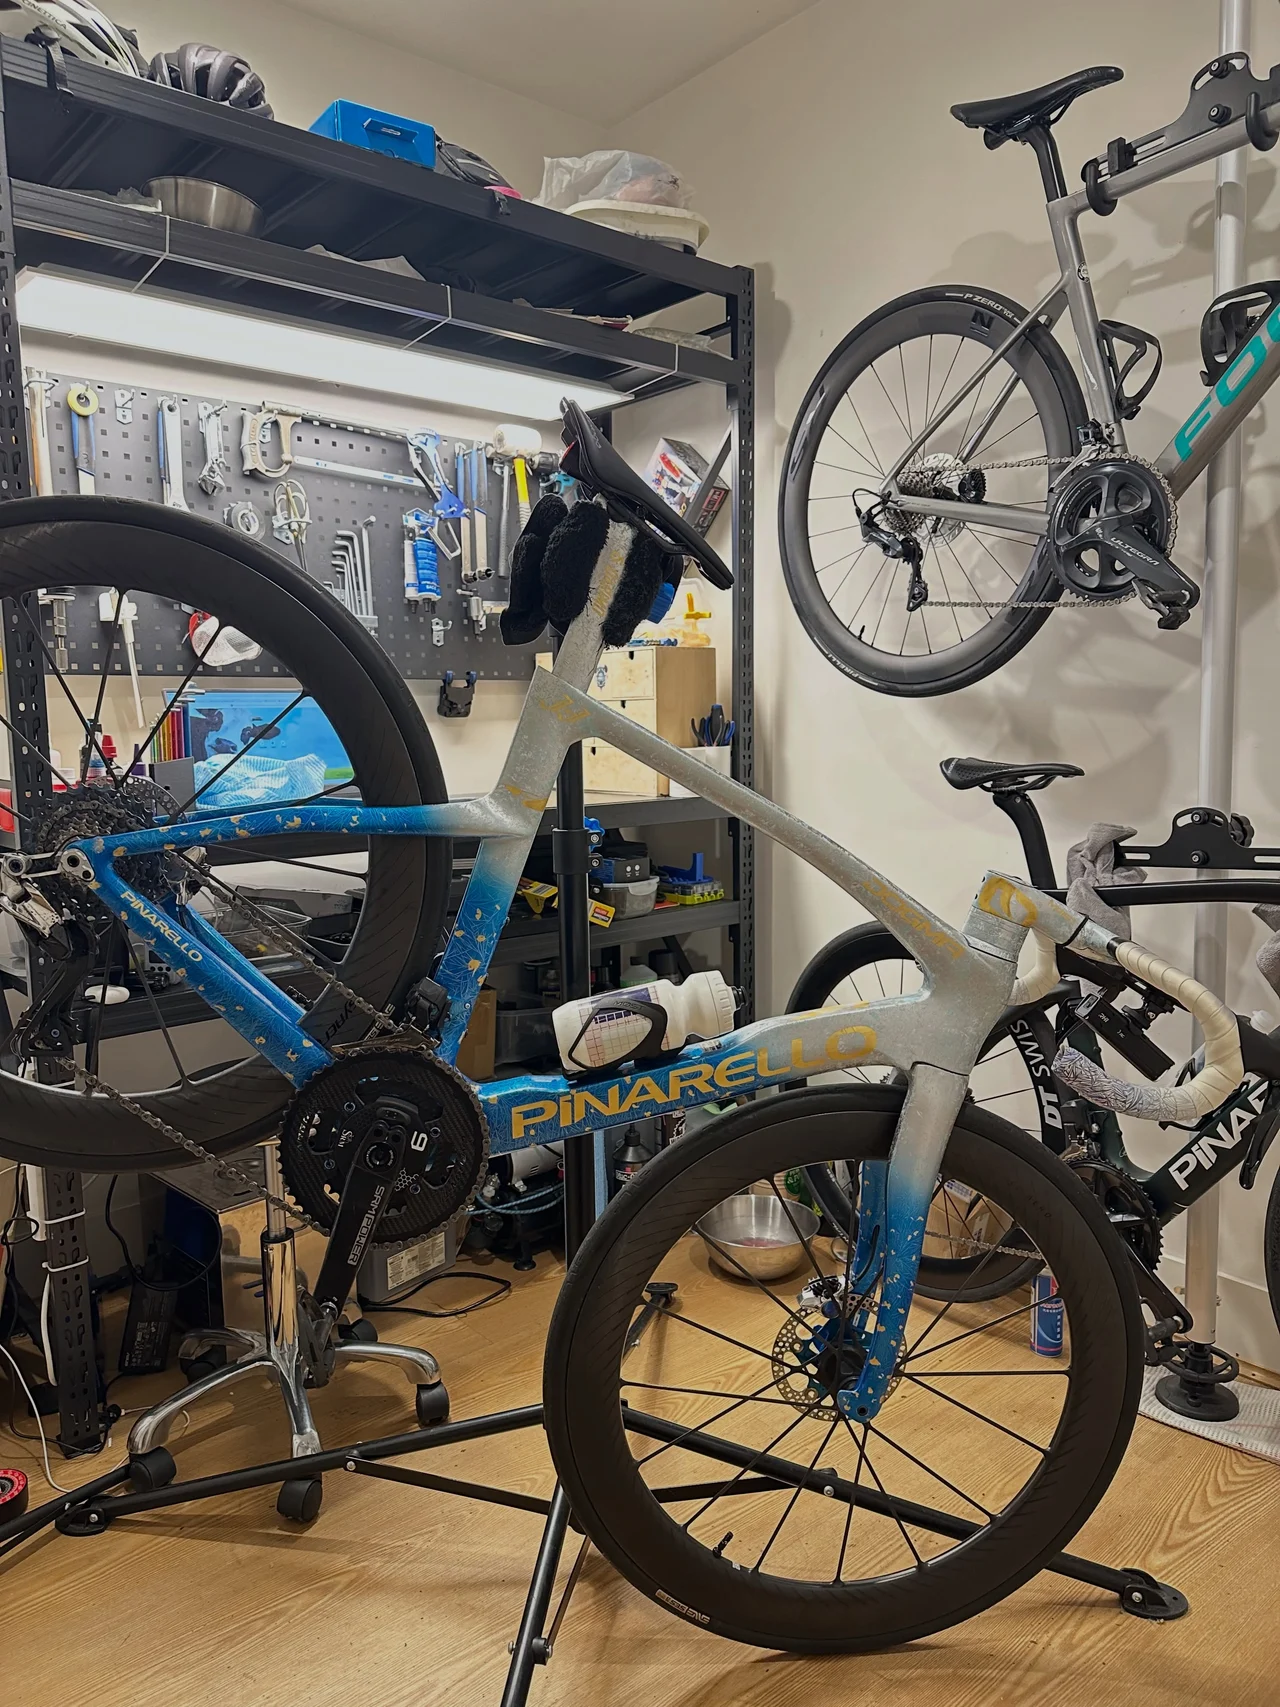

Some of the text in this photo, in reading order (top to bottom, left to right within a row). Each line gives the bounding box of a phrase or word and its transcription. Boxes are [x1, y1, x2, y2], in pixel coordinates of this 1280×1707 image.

[973, 295, 1003, 311] ZERO
[1174, 303, 1280, 462] FO
[1110, 536, 1160, 566] ULTEGRA
[827, 653, 859, 678] PIRELLI
[120, 890, 203, 962] PINARELLO
[1009, 1018, 1063, 1130] DT SWIS
